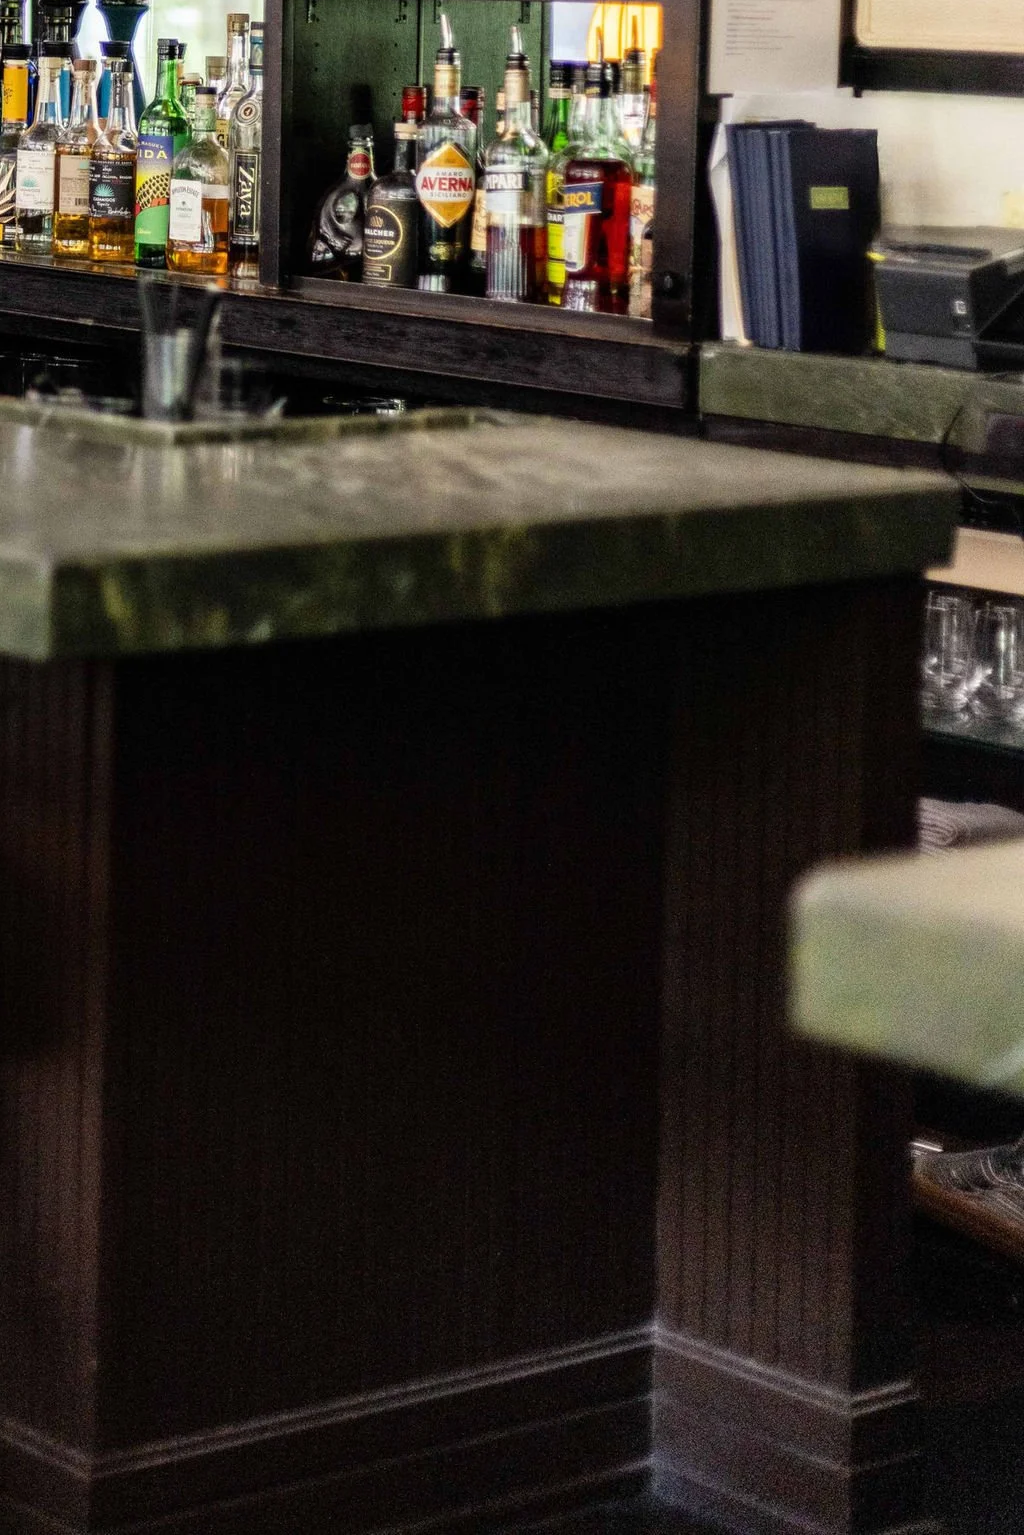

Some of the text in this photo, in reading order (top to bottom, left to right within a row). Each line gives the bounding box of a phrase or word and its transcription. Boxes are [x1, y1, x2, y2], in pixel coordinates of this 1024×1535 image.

[139, 150, 168, 159] IDA
[421, 176, 473, 192] AVERNA
[486, 172, 524, 189] MPARI
[236, 165, 256, 220] Zaya
[564, 191, 595, 207] EROL
